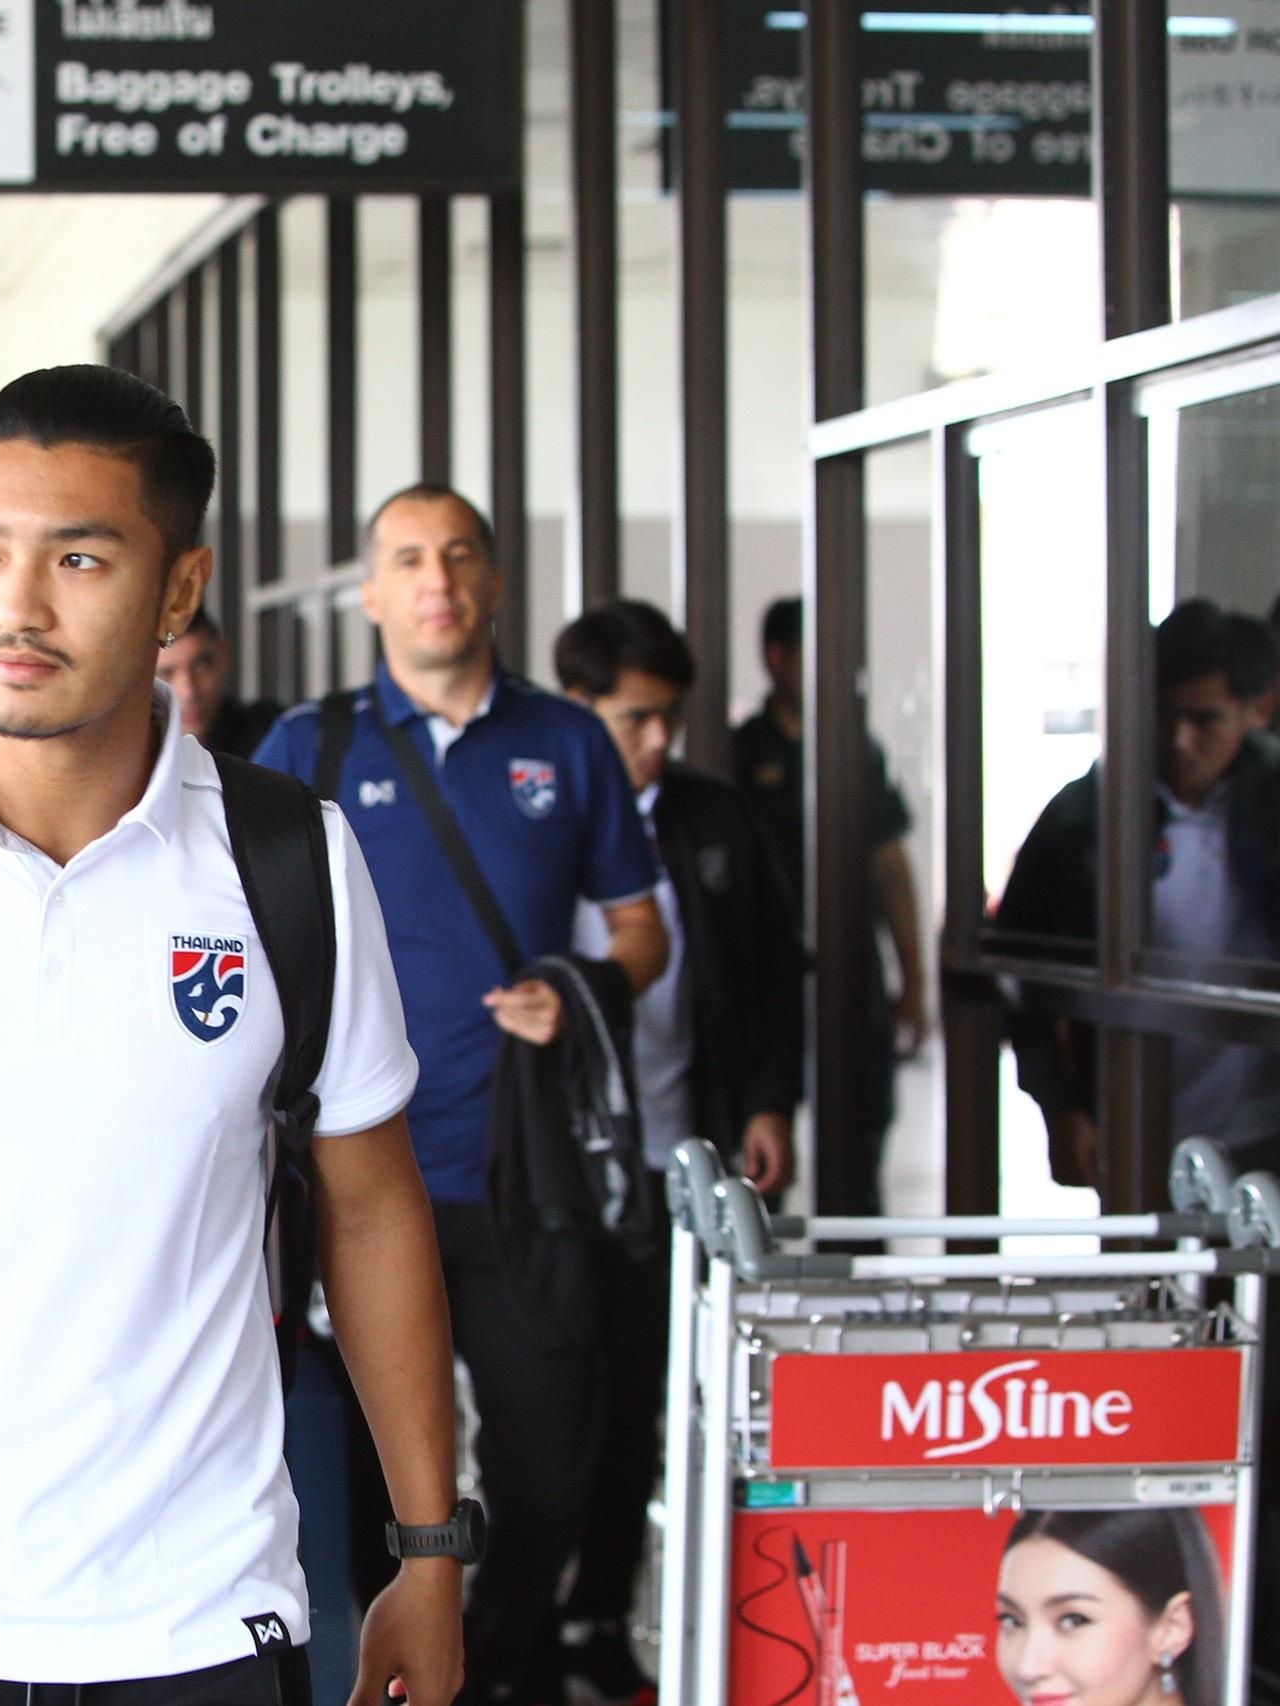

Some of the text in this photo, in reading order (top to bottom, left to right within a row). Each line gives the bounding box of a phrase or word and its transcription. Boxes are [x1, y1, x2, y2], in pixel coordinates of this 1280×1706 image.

[55, 61, 454, 112] Baggage Trolleys,
[55, 112, 408, 165] Free of Charge
[172, 935, 244, 953] THAILAND
[854, 1641, 986, 1663] SUPER BLACK
